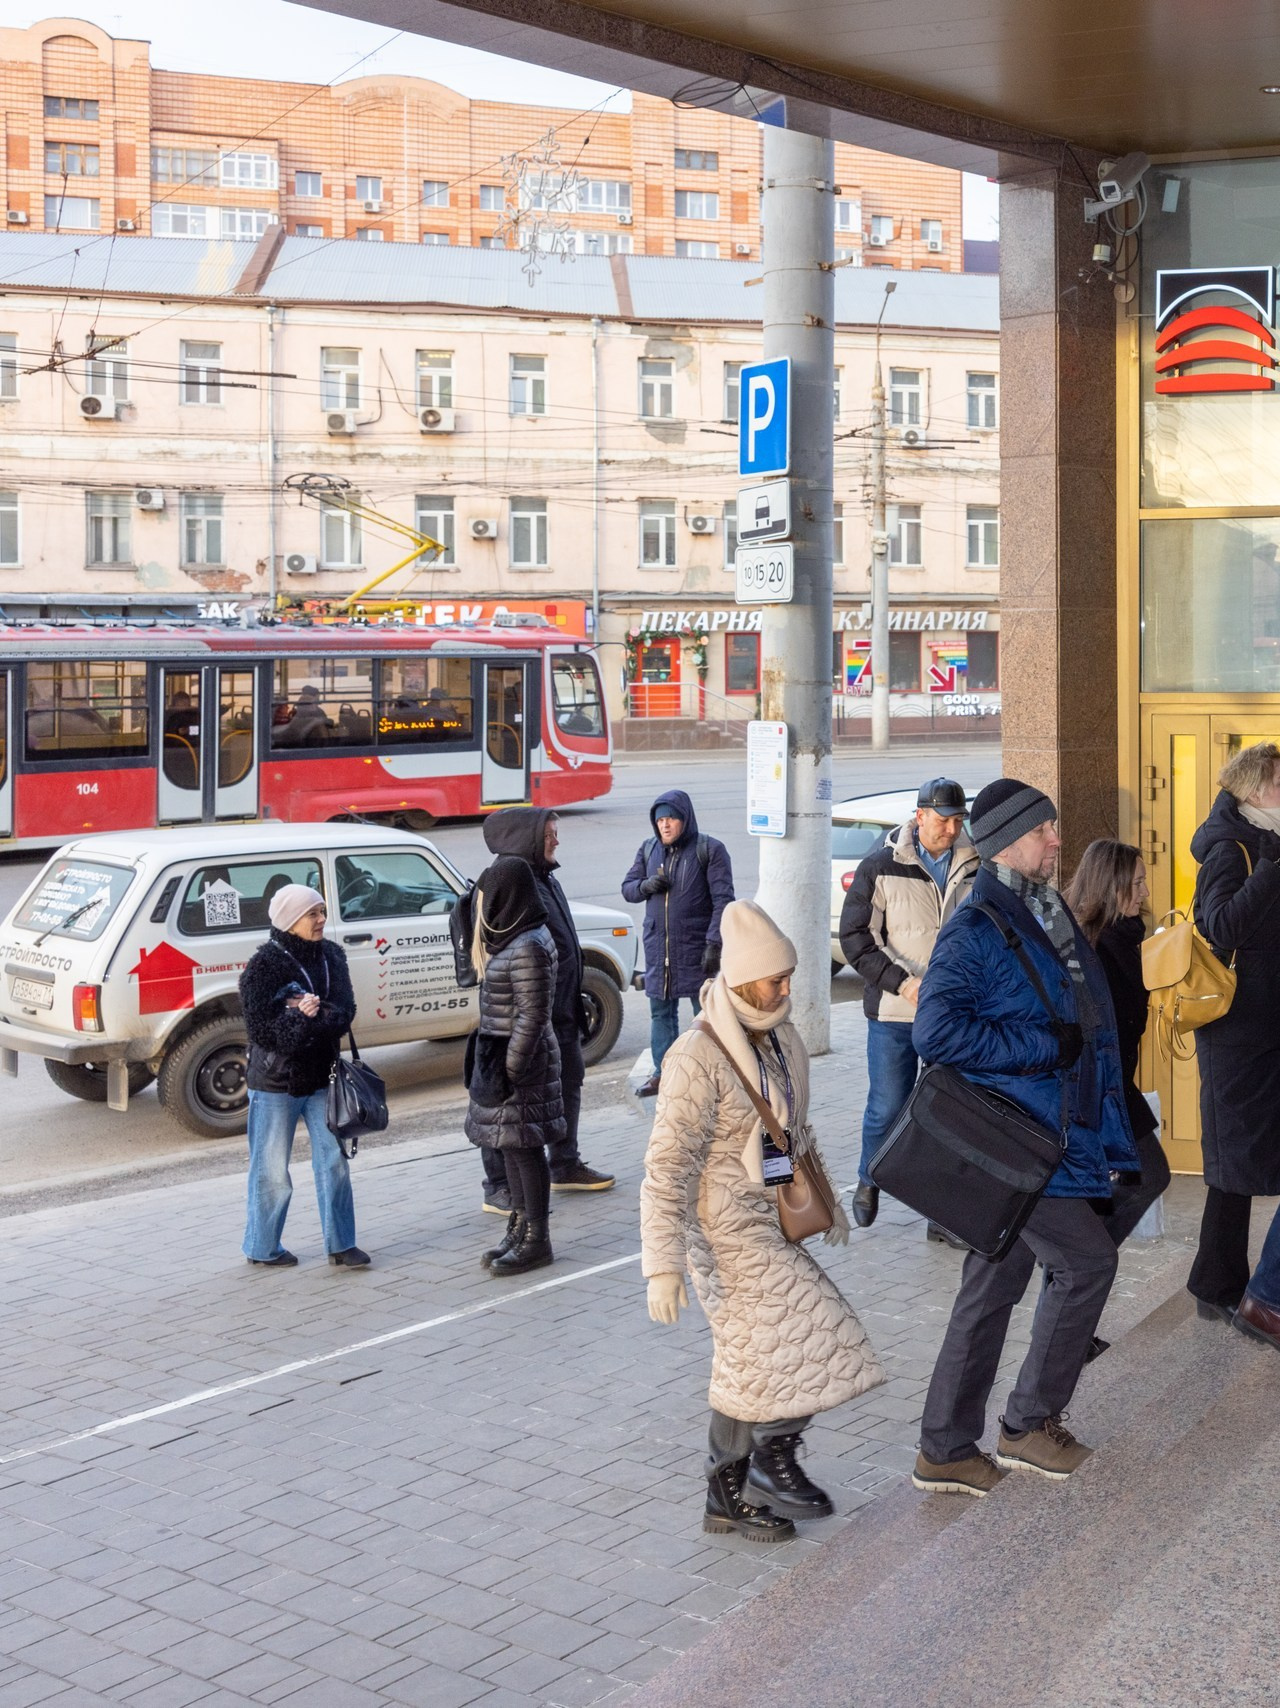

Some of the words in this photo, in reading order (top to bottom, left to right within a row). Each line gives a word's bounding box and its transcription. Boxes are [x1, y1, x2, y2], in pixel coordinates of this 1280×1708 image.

[748, 374, 776, 462] P
[744, 567, 752, 579] 10
[755, 564, 764, 581] 15
[769, 561, 784, 582] 20
[640, 610, 762, 632] ПЕКАРНЯ
[837, 610, 989, 632] КУИНАРИЯ
[943, 694, 980, 705] GOOD
[947, 705, 988, 716] PRINT
[76, 783, 99, 795] 104
[0, 945, 73, 972] СТРОЙПРОСТО
[205, 964, 234, 973] НИВЕ
[390, 968, 420, 976] СТРОИМ
[427, 964, 454, 972] ЭСКРОУ
[390, 979, 418, 987] СТАВКА
[394, 997, 469, 1016] 77-01-55
